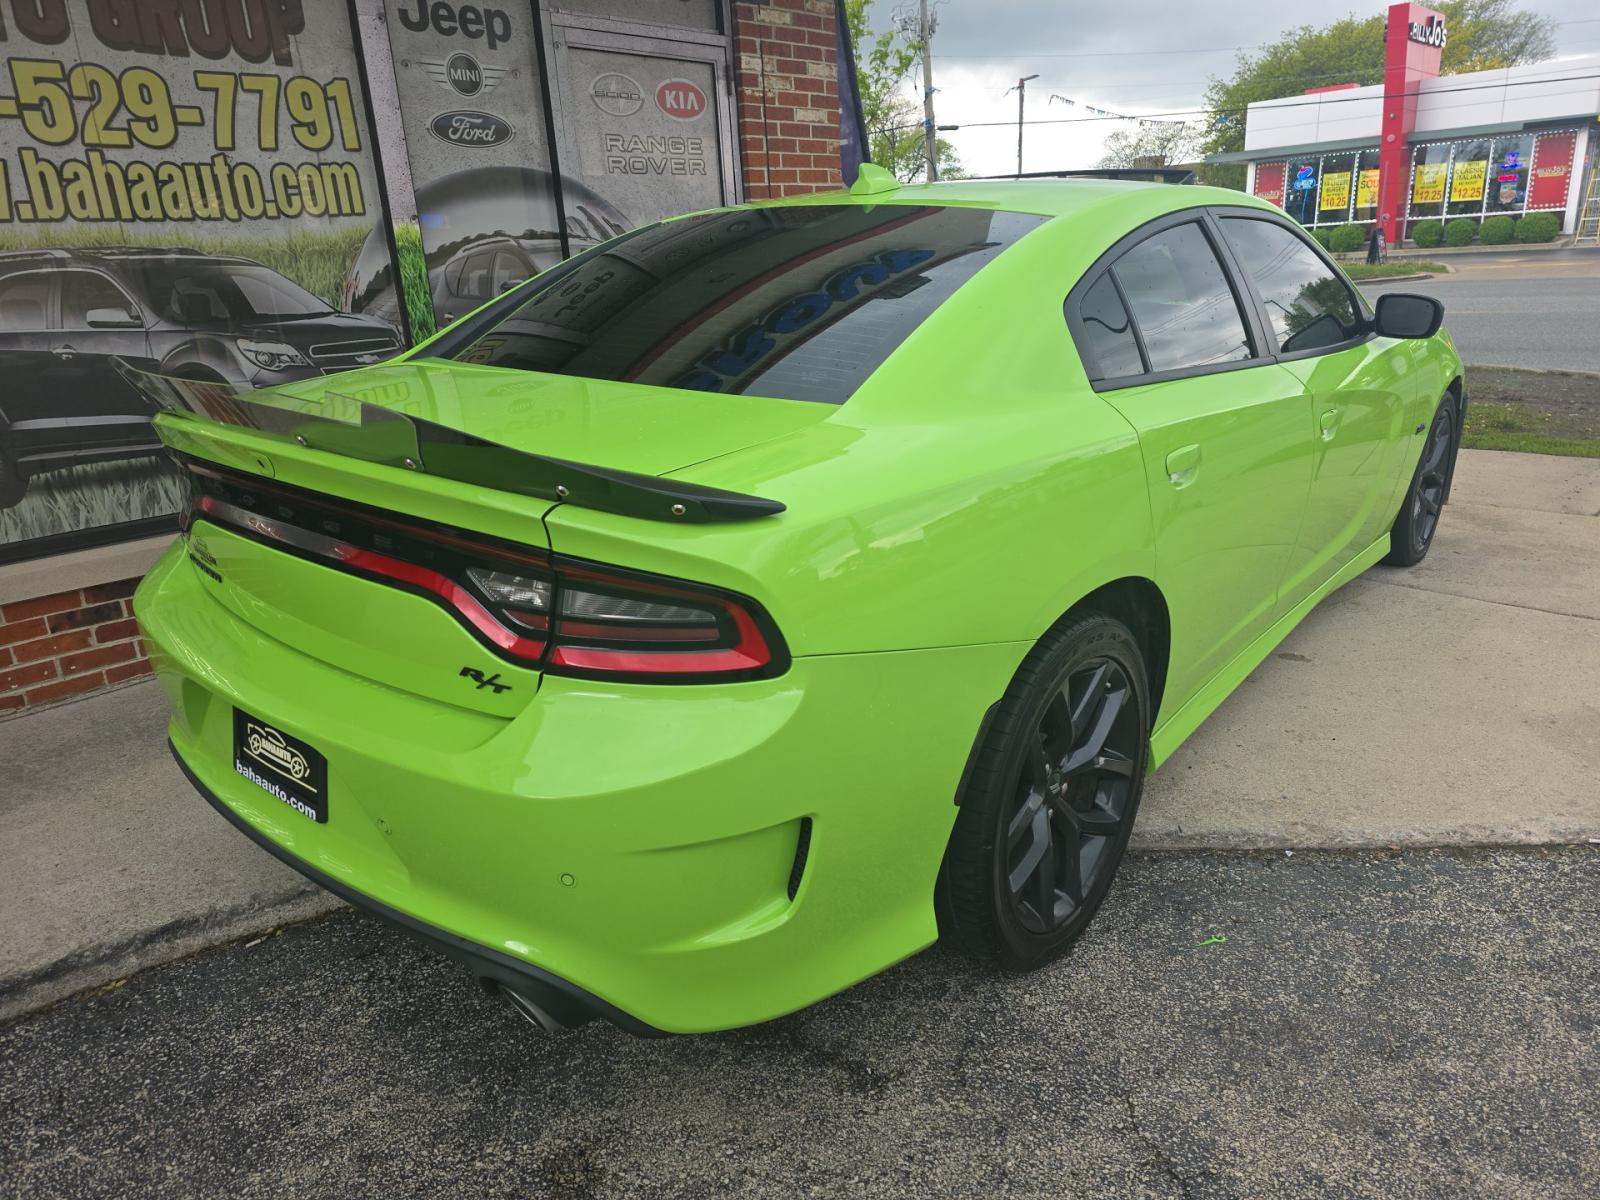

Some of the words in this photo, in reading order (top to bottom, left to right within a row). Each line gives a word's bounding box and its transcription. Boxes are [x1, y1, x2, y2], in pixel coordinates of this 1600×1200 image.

[89, 0, 306, 67] GROUP
[398, 0, 512, 51] Jeep
[450, 68, 480, 82] MINI
[664, 89, 700, 111] KIA
[448, 116, 496, 142] Ford
[604, 133, 704, 155] RANGE
[606, 155, 708, 176] ROVER
[0, 146, 366, 223] .bahaauto.com
[459, 666, 512, 694] R/T
[236, 759, 316, 821] bahaauto.com
